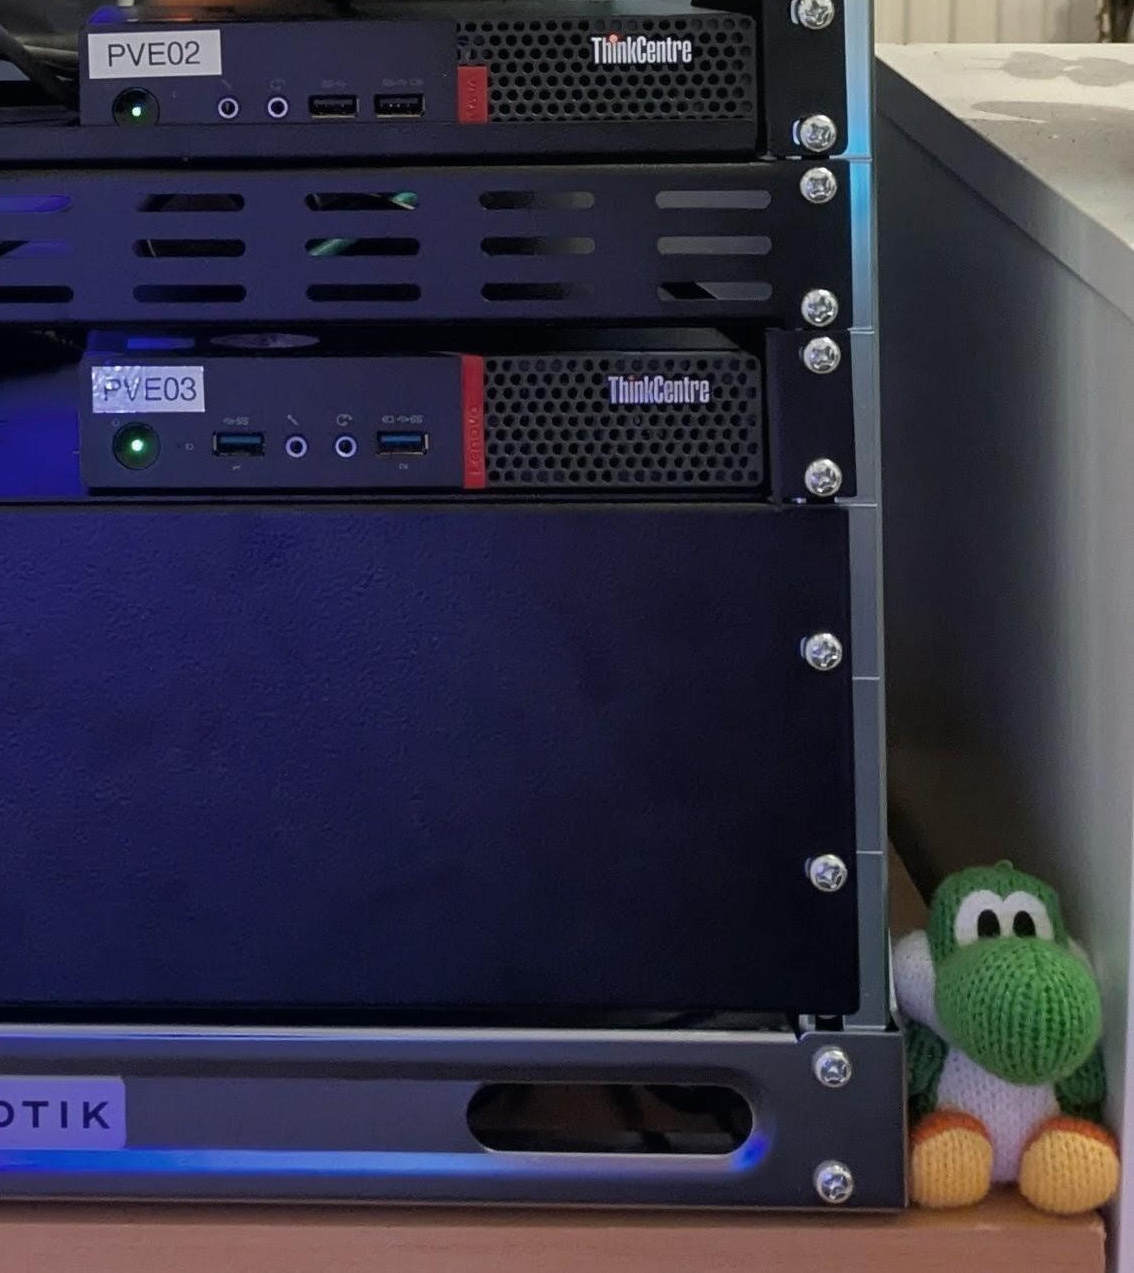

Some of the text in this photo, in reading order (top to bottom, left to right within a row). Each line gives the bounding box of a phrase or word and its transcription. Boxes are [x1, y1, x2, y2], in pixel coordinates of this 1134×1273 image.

[108, 41, 201, 67] PVE02
[590, 35, 693, 64] ThinkCentre
[104, 376, 197, 401] PVE03
[608, 375, 710, 404] ThinkCentre
